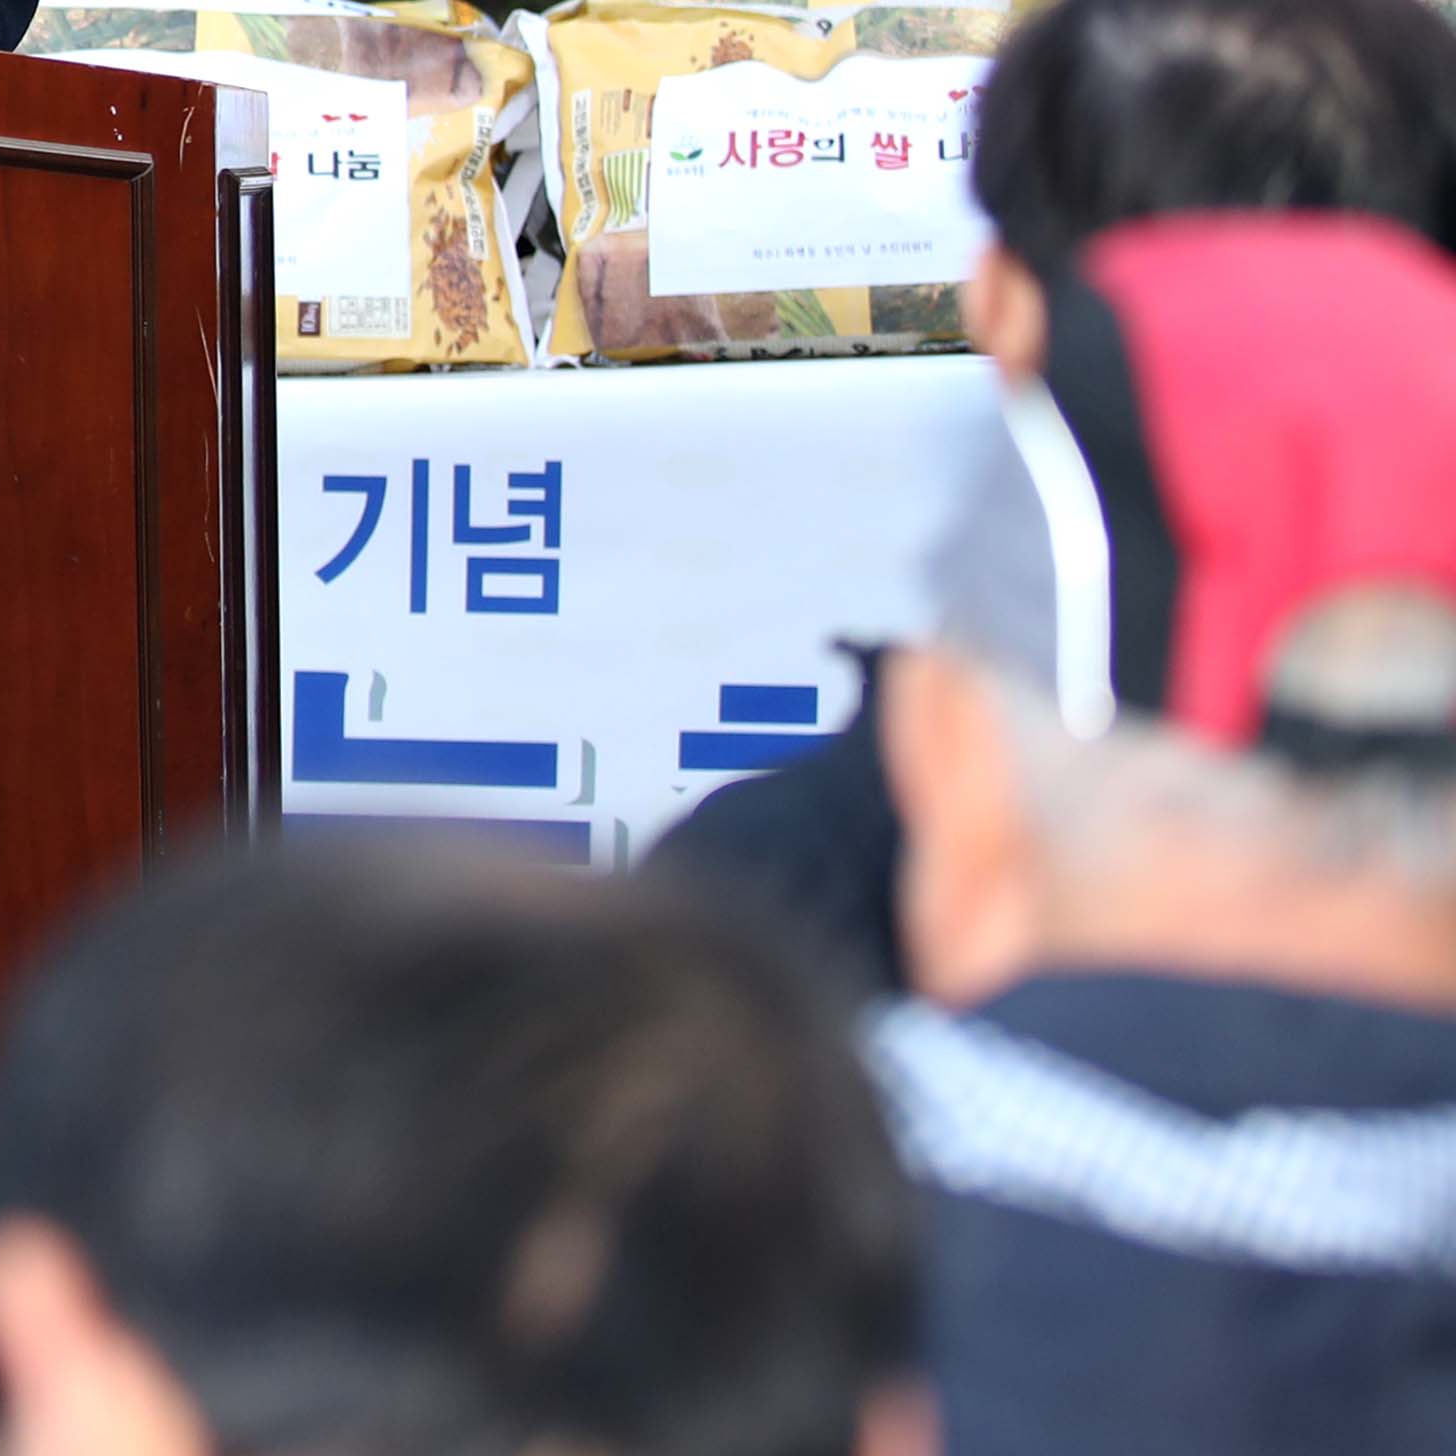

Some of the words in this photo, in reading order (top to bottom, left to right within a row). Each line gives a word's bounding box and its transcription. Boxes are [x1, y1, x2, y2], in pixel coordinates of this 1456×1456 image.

[307, 149, 381, 181] 나눔
[717, 129, 846, 169] 사랑의
[870, 131, 913, 171] 쌀
[313, 457, 564, 615] 기념
